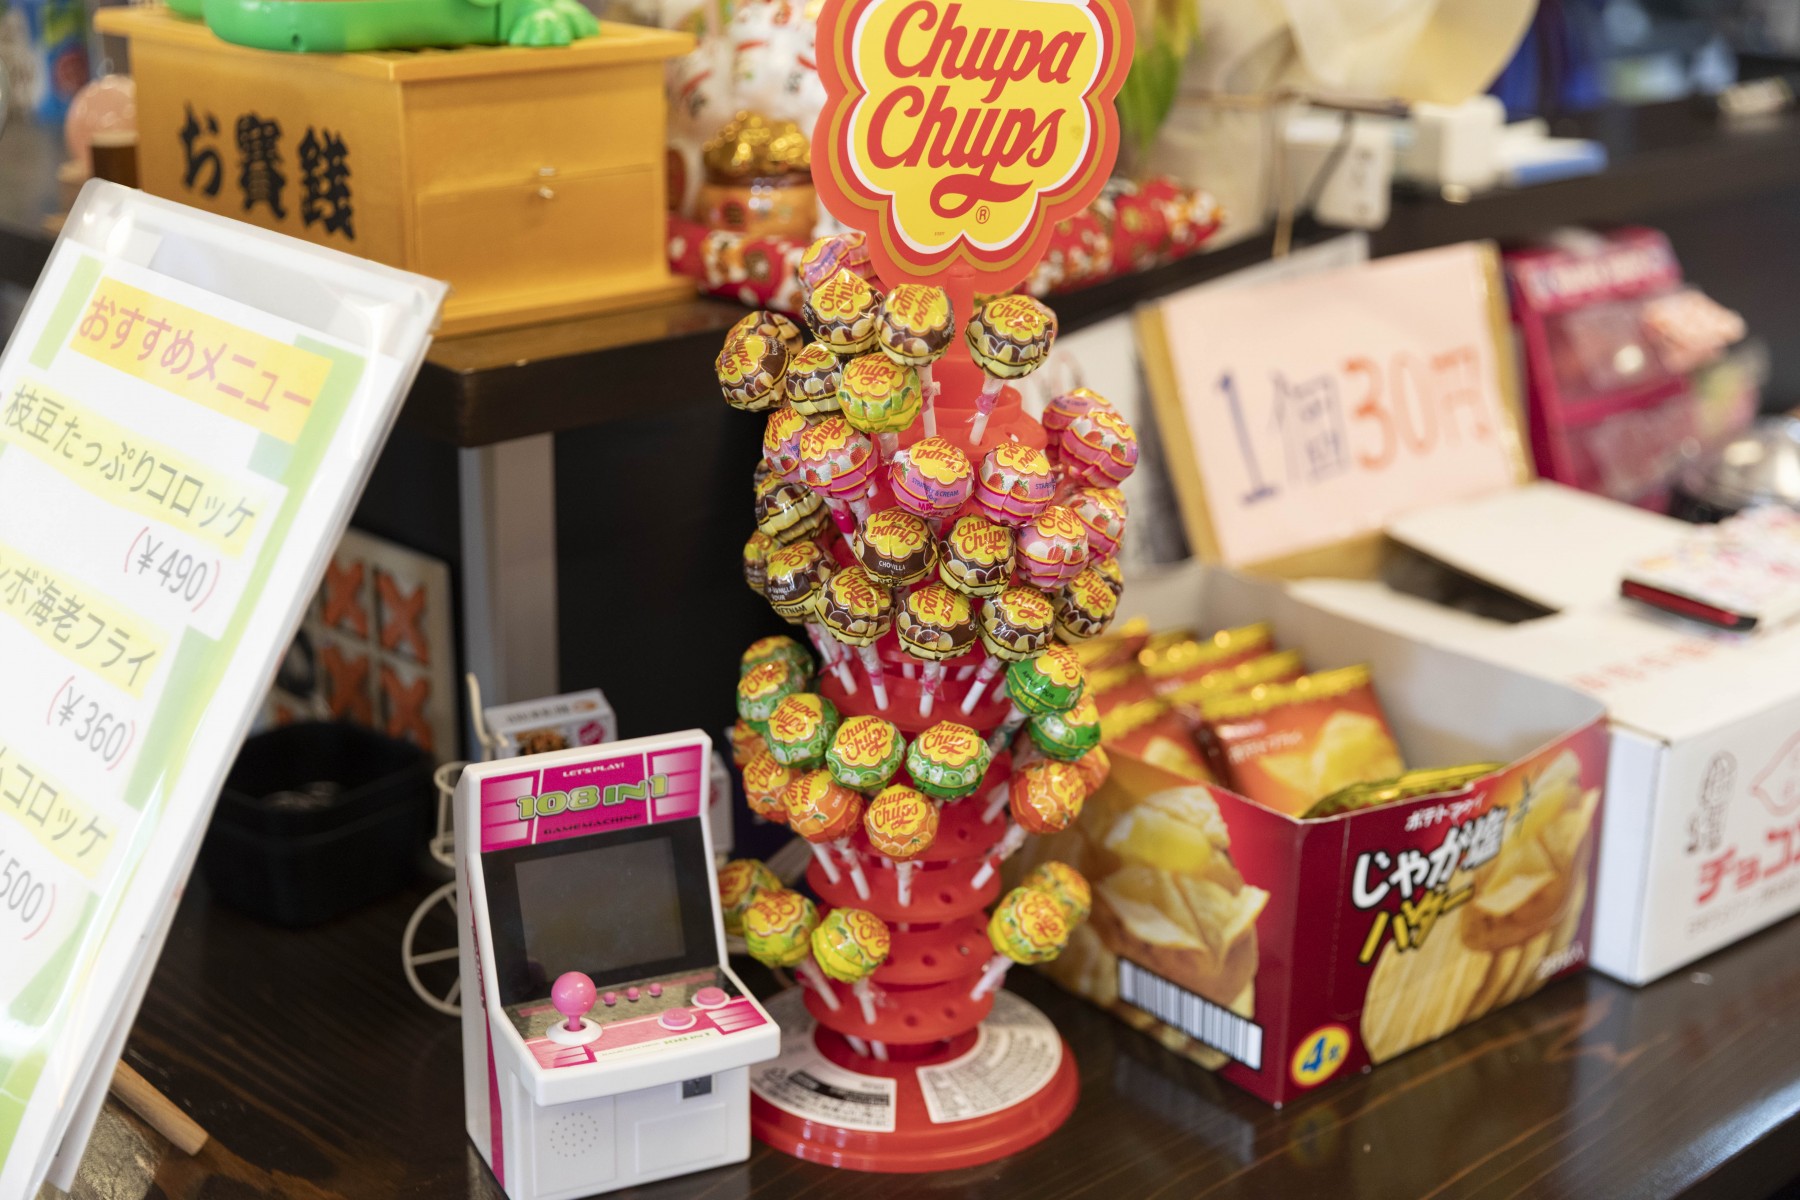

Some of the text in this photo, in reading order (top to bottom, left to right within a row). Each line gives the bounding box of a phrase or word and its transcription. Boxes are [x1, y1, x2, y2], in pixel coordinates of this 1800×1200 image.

[884, 0, 1087, 103] Chupa
[867, 85, 1066, 218] Chups
[180, 100, 354, 240] お賽銭
[80, 296, 312, 412] おすすめメニュー
[5, 385, 255, 538] 枝豆たっぷりコロッケ
[957, 519, 991, 537] Chup
[962, 527, 1007, 554] Chups
[836, 575, 877, 609] Chups
[1002, 592, 1050, 619] Chups
[47, 675, 135, 771] (¥360)
[838, 718, 879, 745] Chupa
[846, 724, 888, 760] Chups
[924, 733, 971, 754] Chups
[562, 762, 625, 778] LET'S PLAY!
[517, 785, 599, 820] 108
[872, 791, 916, 811] Chupa
[874, 802, 918, 830] Chups
[1353, 806, 1508, 909] じゃが塩
[1696, 818, 1800, 905] チョコ
[0, 850, 56, 941] 500)
[1359, 885, 1474, 964] バター
